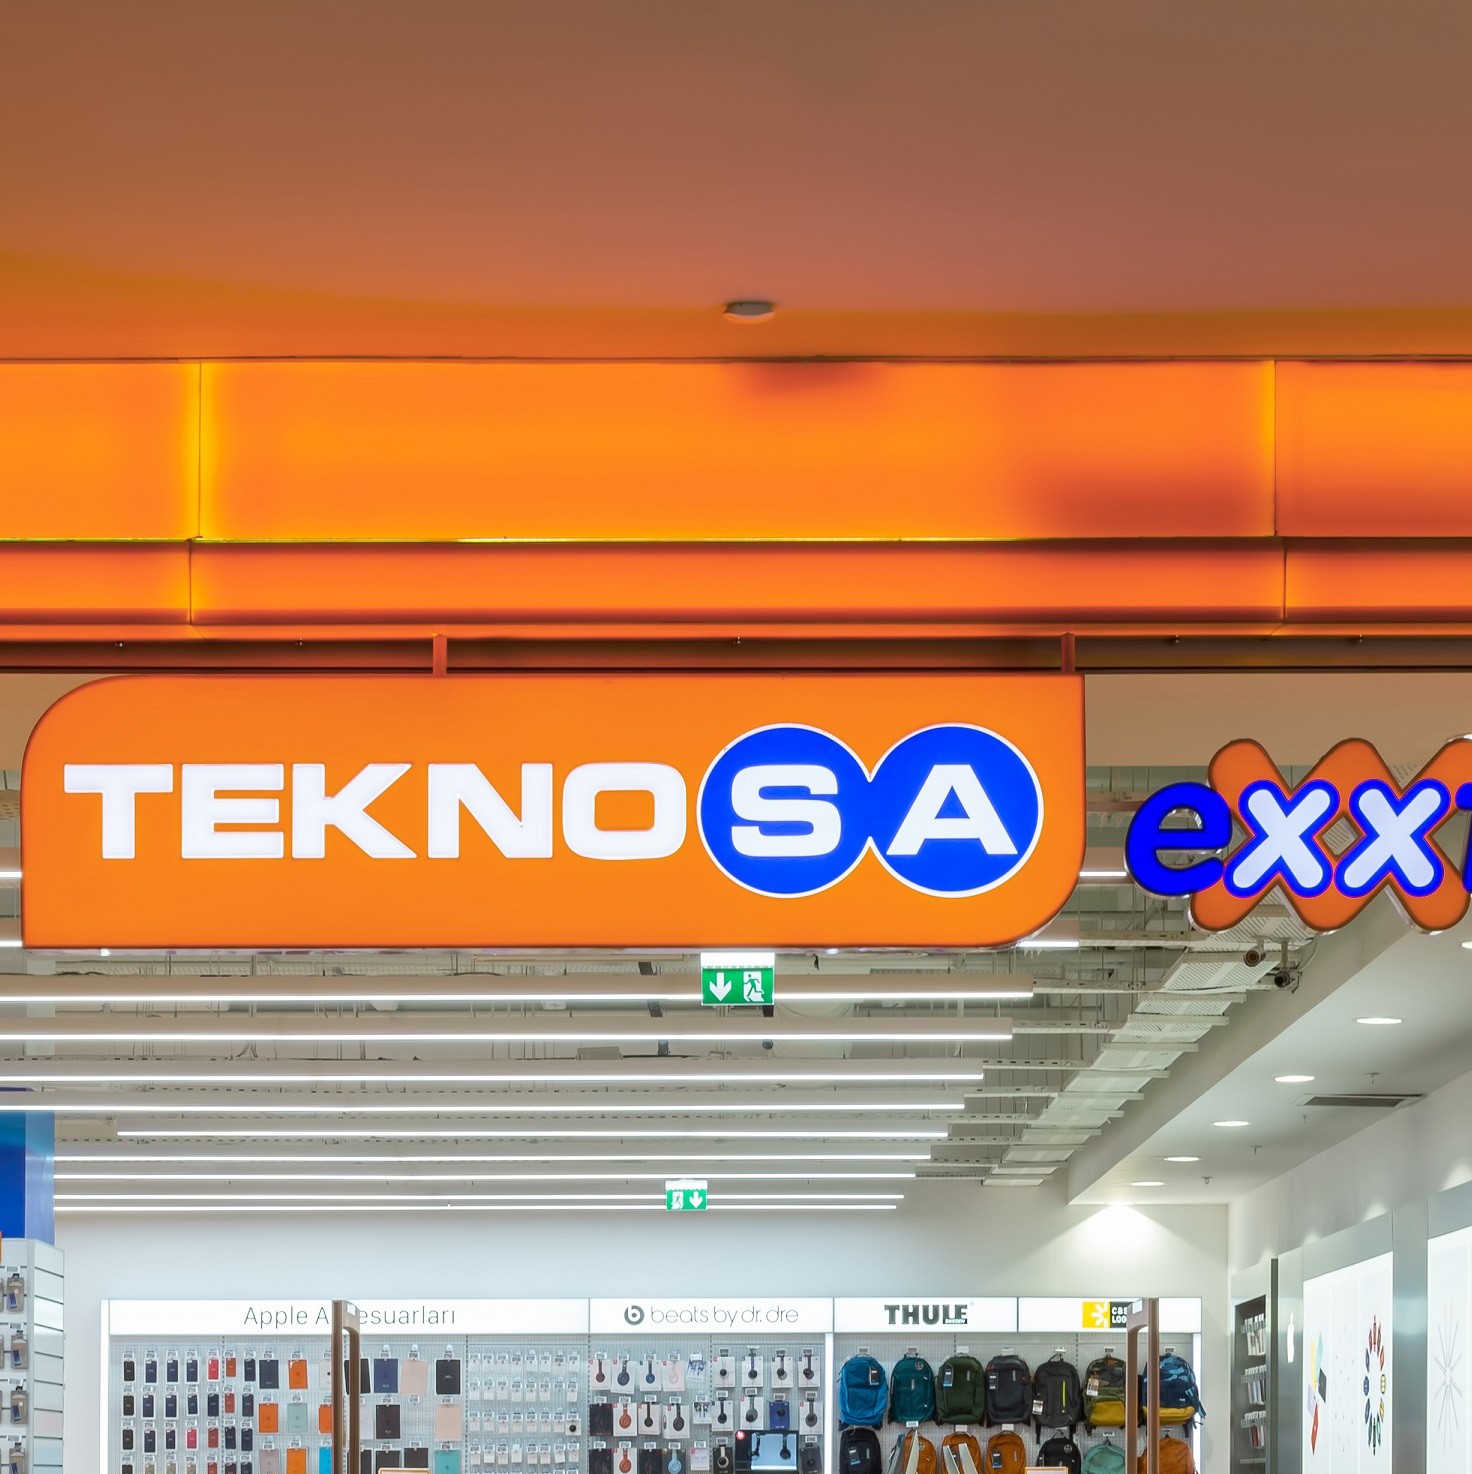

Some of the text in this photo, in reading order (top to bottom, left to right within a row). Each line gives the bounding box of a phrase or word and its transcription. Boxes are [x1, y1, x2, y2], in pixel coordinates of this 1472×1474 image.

[63, 762, 1019, 859] TEKNOSA
[243, 1306, 456, 1329] Apple Aesuarları
[650, 1305, 799, 1327] beats by dr. dre
[884, 1304, 968, 1325] THULE
[1111, 1306, 1128, 1315] cas
